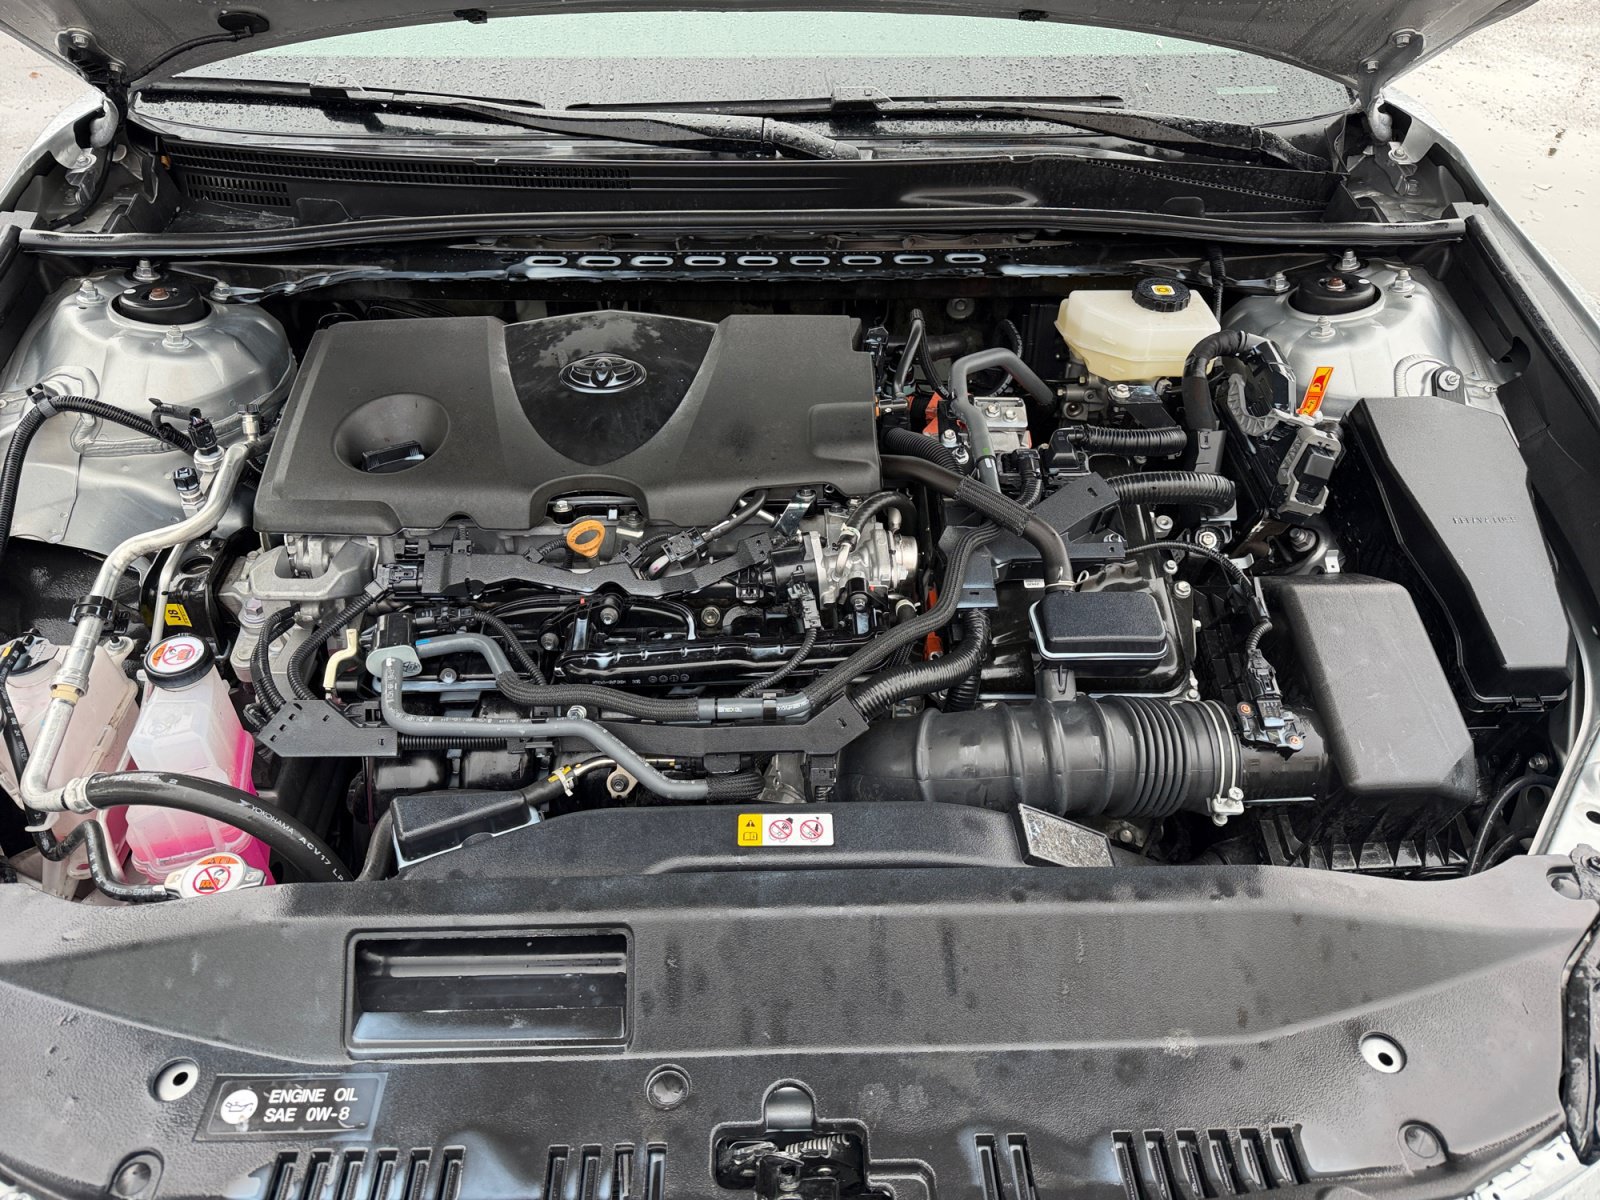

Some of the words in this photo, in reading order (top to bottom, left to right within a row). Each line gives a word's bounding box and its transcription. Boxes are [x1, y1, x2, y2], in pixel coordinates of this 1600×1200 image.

[251, 804, 295, 835] YOKOHAMA
[299, 836, 332, 866] ACV17
[332, 868, 345, 881] LP
[269, 1089, 326, 1103] ENGINE
[334, 1088, 358, 1101] OIL
[264, 1108, 297, 1123] SAE
[306, 1107, 350, 1121] 0W-8
